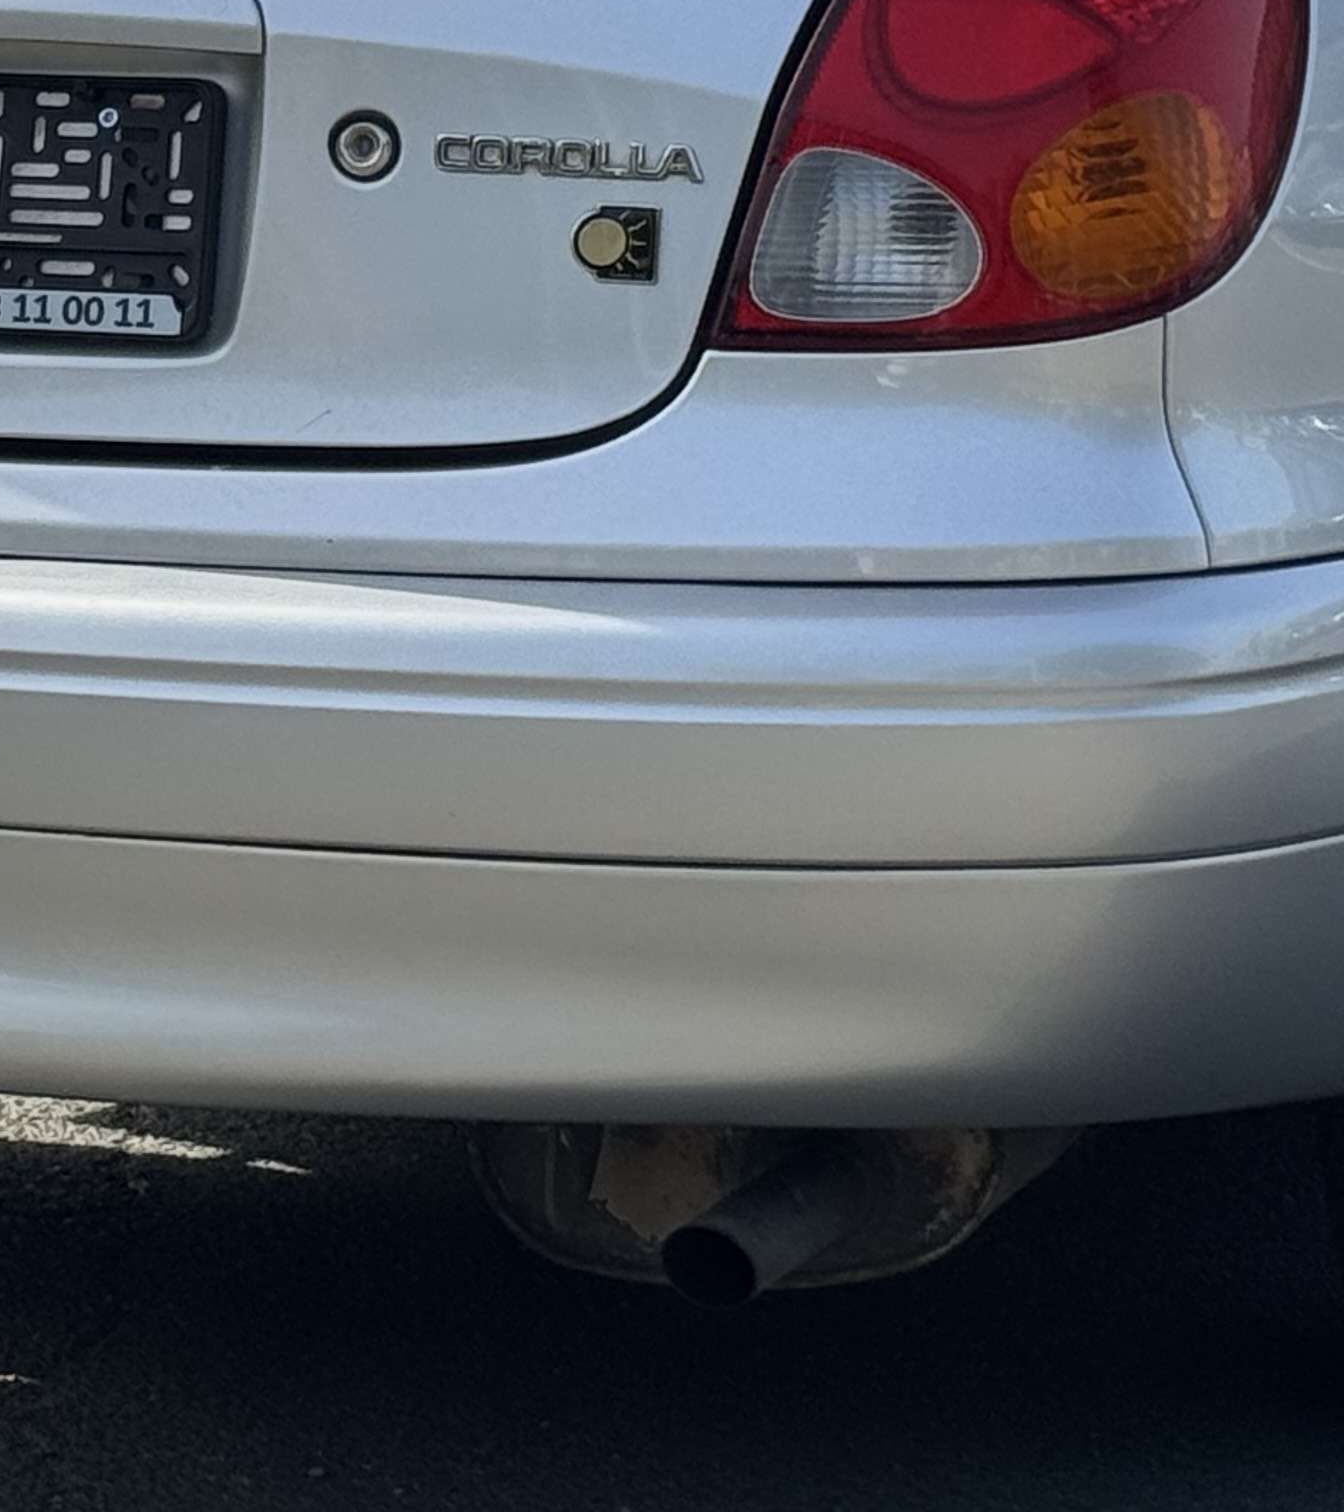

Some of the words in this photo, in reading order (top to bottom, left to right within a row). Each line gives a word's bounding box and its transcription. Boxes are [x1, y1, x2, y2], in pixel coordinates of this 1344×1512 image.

[432, 131, 706, 185] COROLLA
[12, 294, 53, 324] 11
[62, 296, 105, 327] 00
[114, 298, 156, 330] 11
